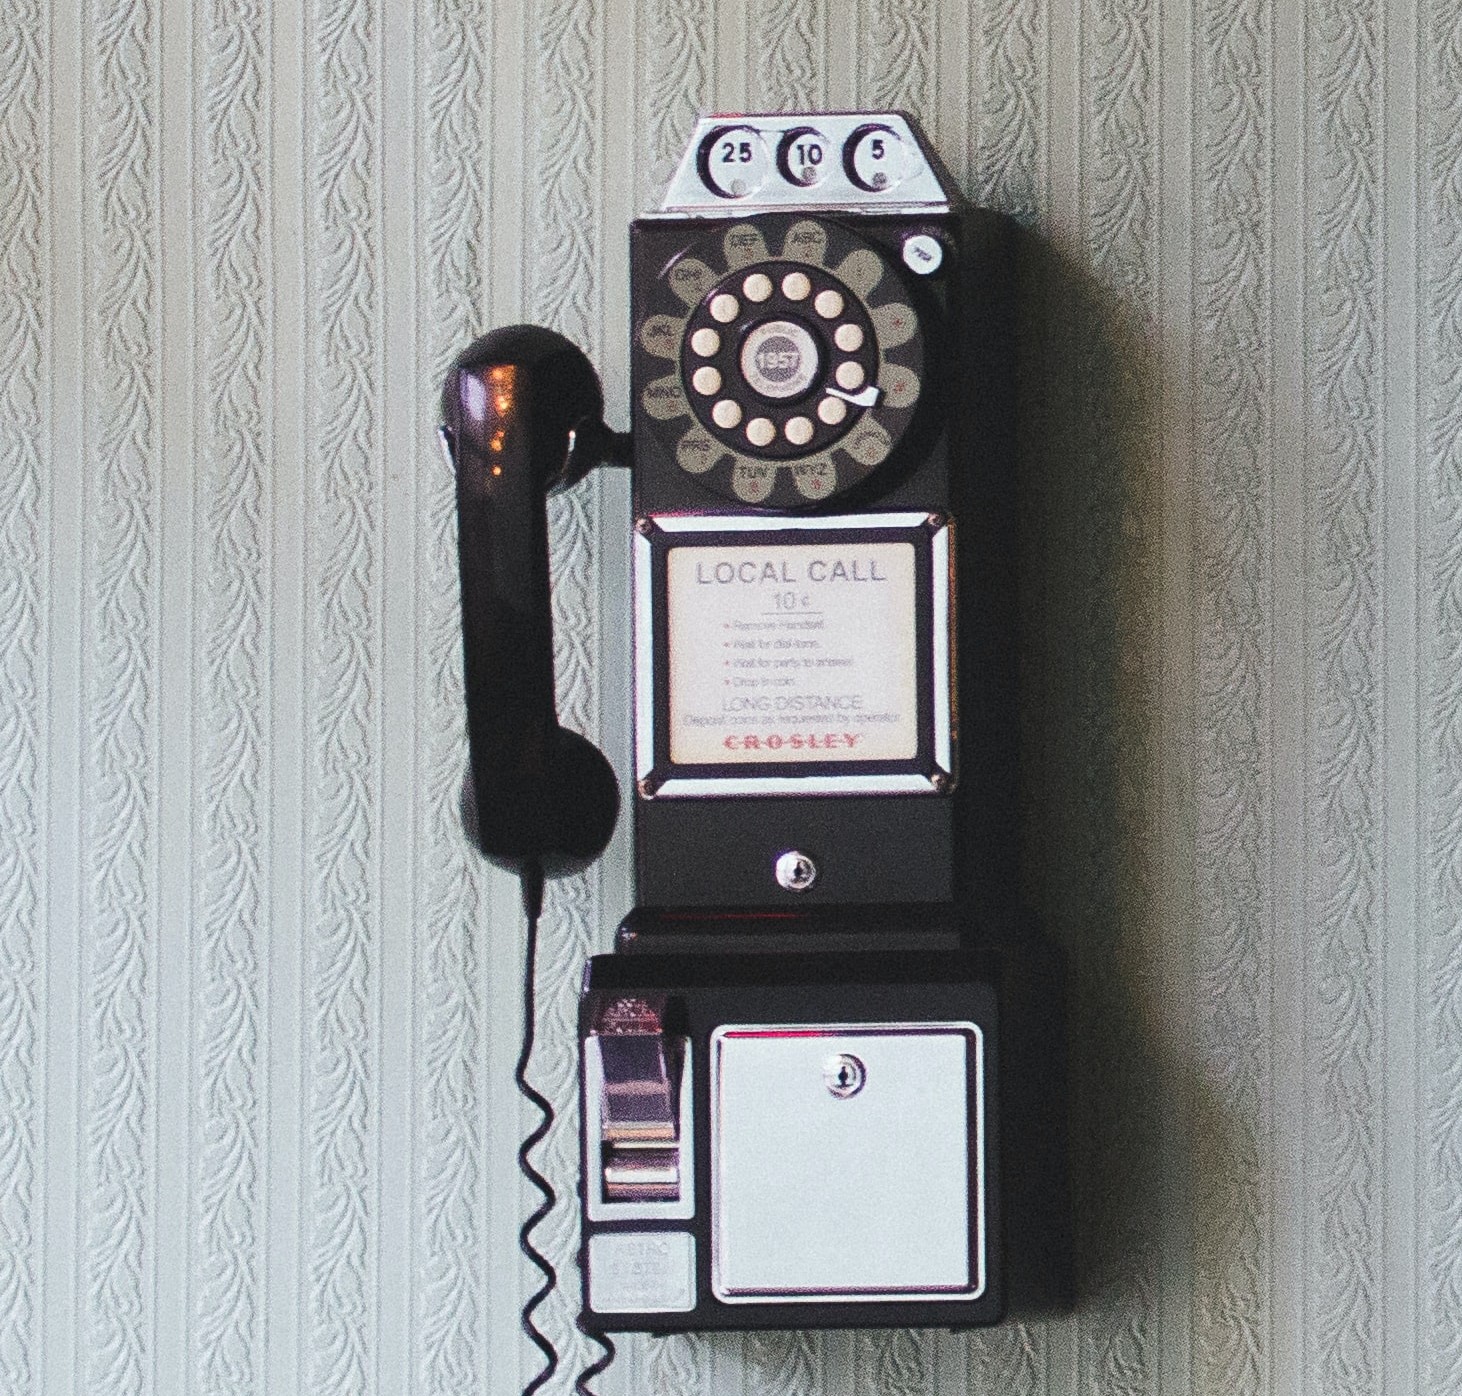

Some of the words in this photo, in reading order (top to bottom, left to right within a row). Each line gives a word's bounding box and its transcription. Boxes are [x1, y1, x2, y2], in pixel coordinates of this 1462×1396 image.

[722, 142, 752, 162] 25
[797, 144, 822, 165] 10
[871, 139, 885, 160] 5
[792, 230, 823, 244] ABC
[757, 352, 799, 369] 1957
[697, 561, 796, 584] LOCAL
[807, 560, 886, 582] CALL
[773, 592, 796, 609] 10
[733, 620, 776, 631] Remove
[757, 639, 770, 649] for
[757, 657, 770, 668] for
[802, 658, 814, 668] to
[733, 677, 759, 688] Drop
[722, 696, 770, 712] LONG
[775, 695, 863, 711] DISTANCE
[683, 715, 724, 727] Deposit
[759, 716, 775, 725] as
[778, 713, 833, 726] requested
[835, 713, 850, 727] by
[722, 733, 860, 750] CROSLEY
